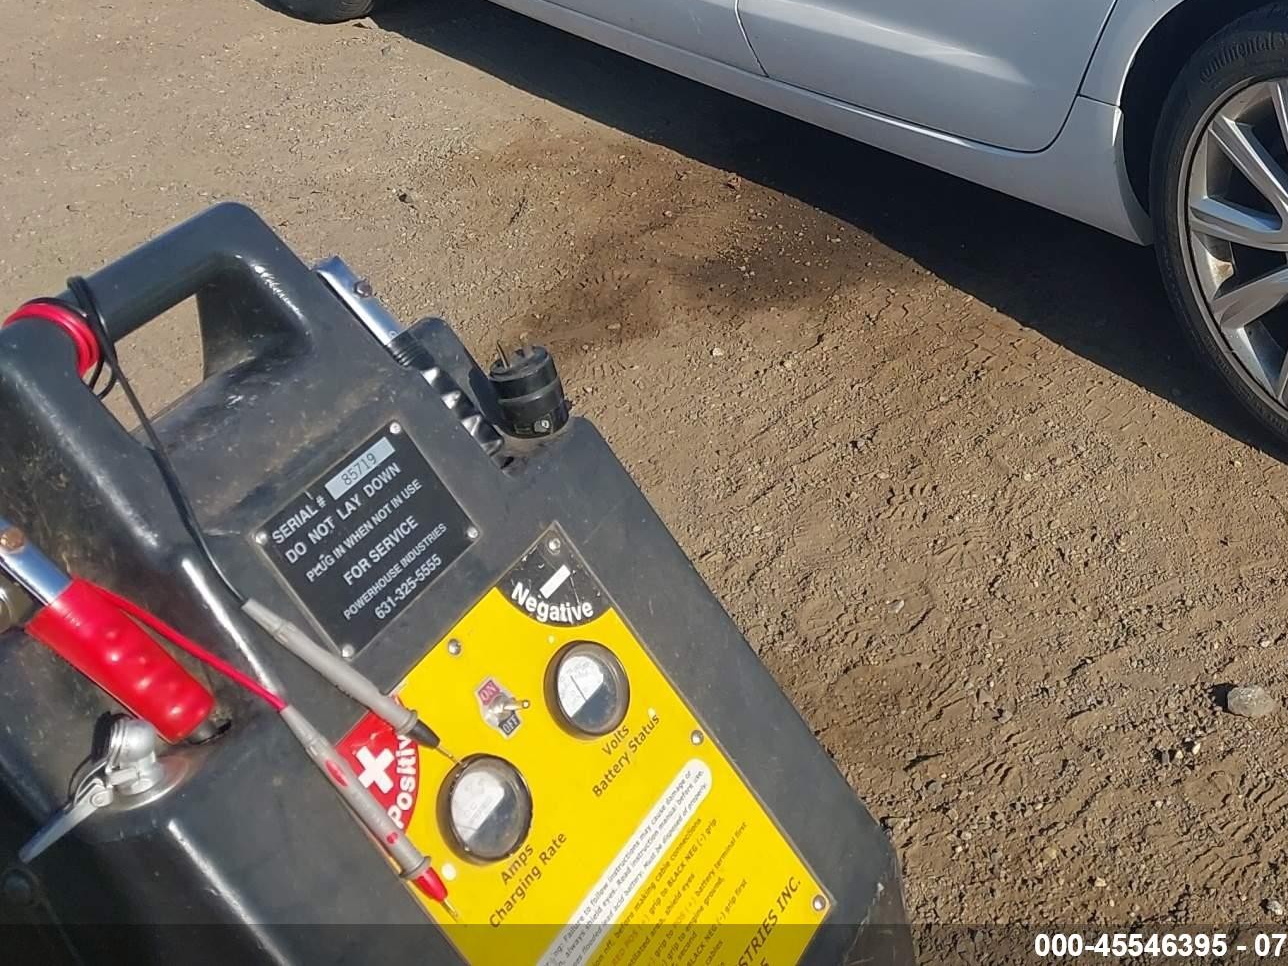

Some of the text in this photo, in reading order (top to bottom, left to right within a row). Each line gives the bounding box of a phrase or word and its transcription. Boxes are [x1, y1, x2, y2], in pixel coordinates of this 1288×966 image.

[271, 452, 378, 544] SERIAL # 85719
[284, 463, 401, 564] DO NOT LAY DOWN
[306, 478, 423, 582] PLUG IN WHEN NOT IN USE
[342, 515, 420, 586] FOR SERVICE
[343, 523, 449, 621] POWERHOUSE INDUSTRIES
[374, 554, 443, 621] 631-325-5555
[511, 581, 594, 625] Negative
[480, 684, 497, 701] ON
[502, 713, 519, 734] OFF
[387, 733, 418, 830] Positiv
[591, 714, 661, 798] Battery Status
[601, 723, 631, 756] Volts
[488, 832, 568, 929] Charging Rate
[500, 843, 535, 885] Amps
[563, 915, 584, 941] Failure
[589, 882, 608, 906] follow
[607, 840, 640, 882] instructions
[665, 778, 685, 805] damage
[564, 930, 585, 958] always
[630, 829, 659, 867] instruction
[633, 881, 656, 911] making
[654, 860, 670, 882] cable
[669, 818, 701, 861] connections
[648, 896, 661, 915] grip
[666, 860, 686, 887] BLACK
[684, 844, 698, 861] NEG
[704, 818, 717, 835] grip
[713, 836, 736, 869] terminal
[776, 875, 803, 913] INC.
